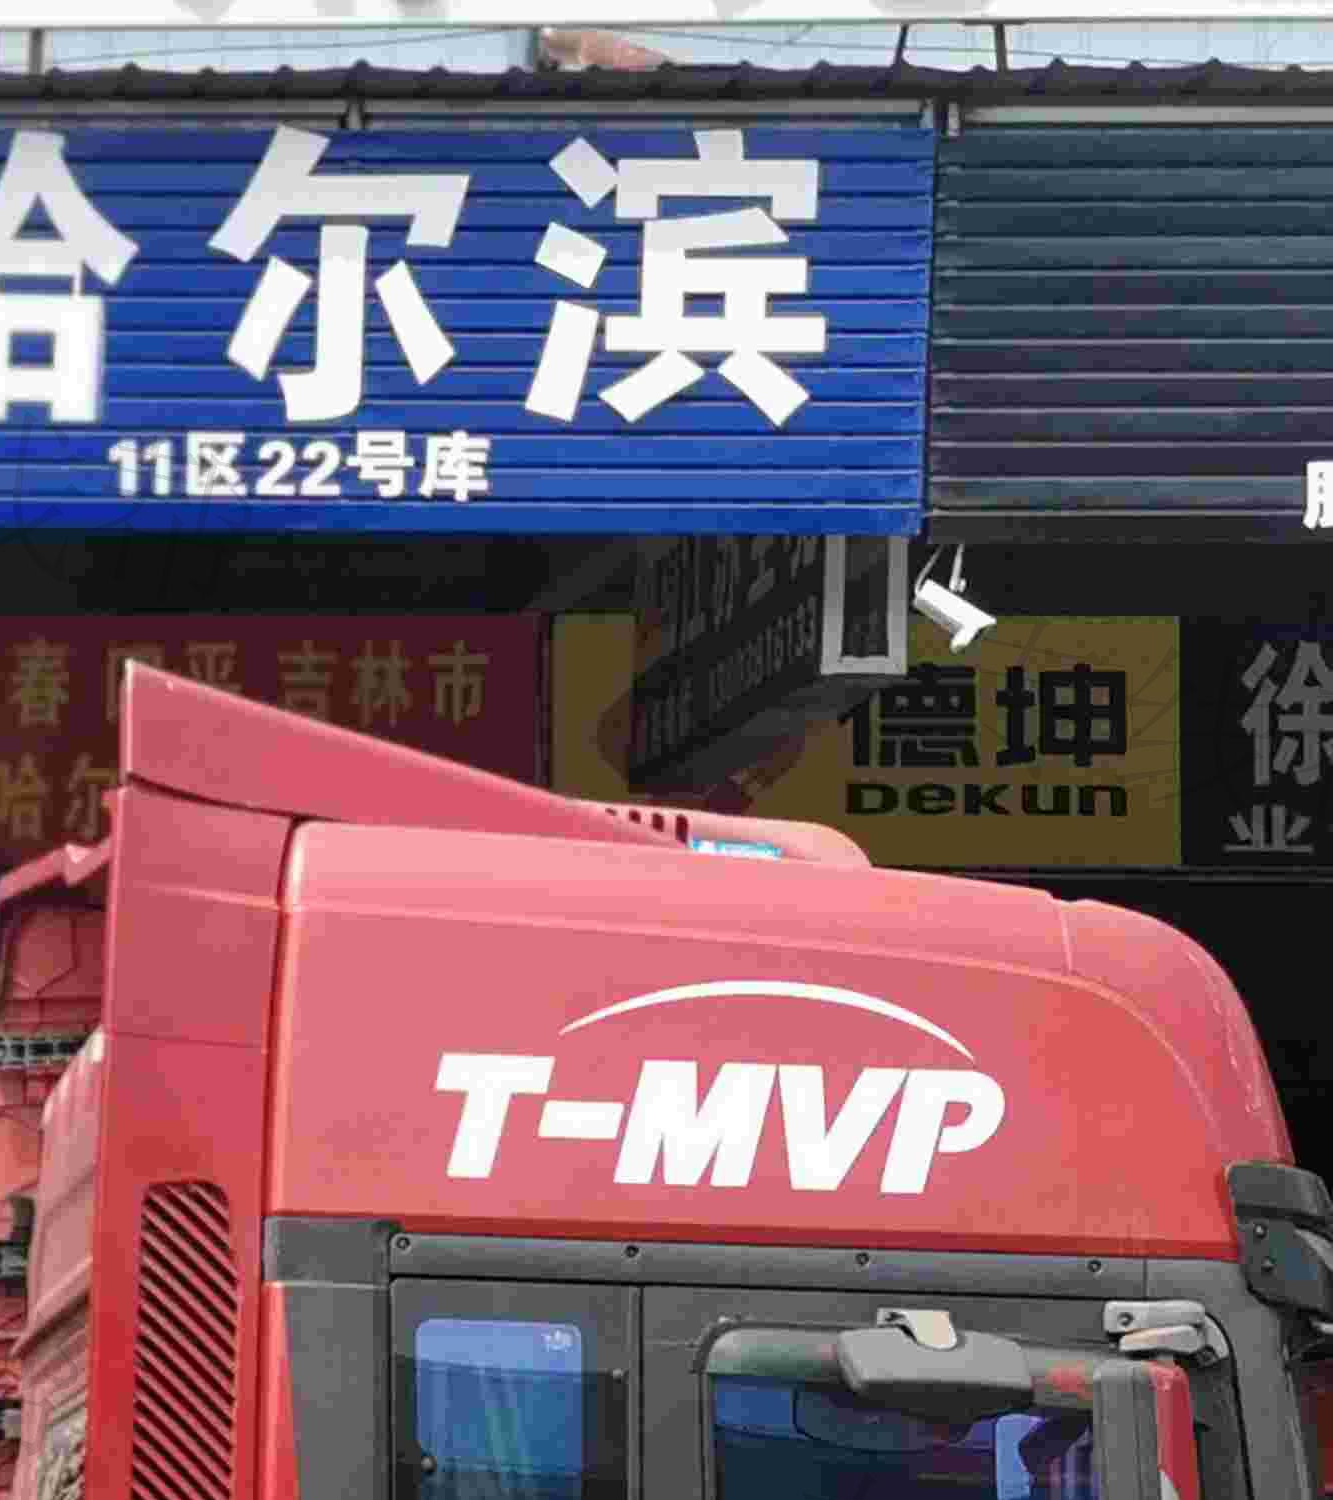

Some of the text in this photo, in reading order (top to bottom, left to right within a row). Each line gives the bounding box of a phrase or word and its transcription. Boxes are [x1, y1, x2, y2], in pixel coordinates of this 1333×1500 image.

[106, 430, 493, 503] 11区22号库
[840, 661, 1128, 768] 德坤
[435, 1052, 1007, 1195] T-MVP
